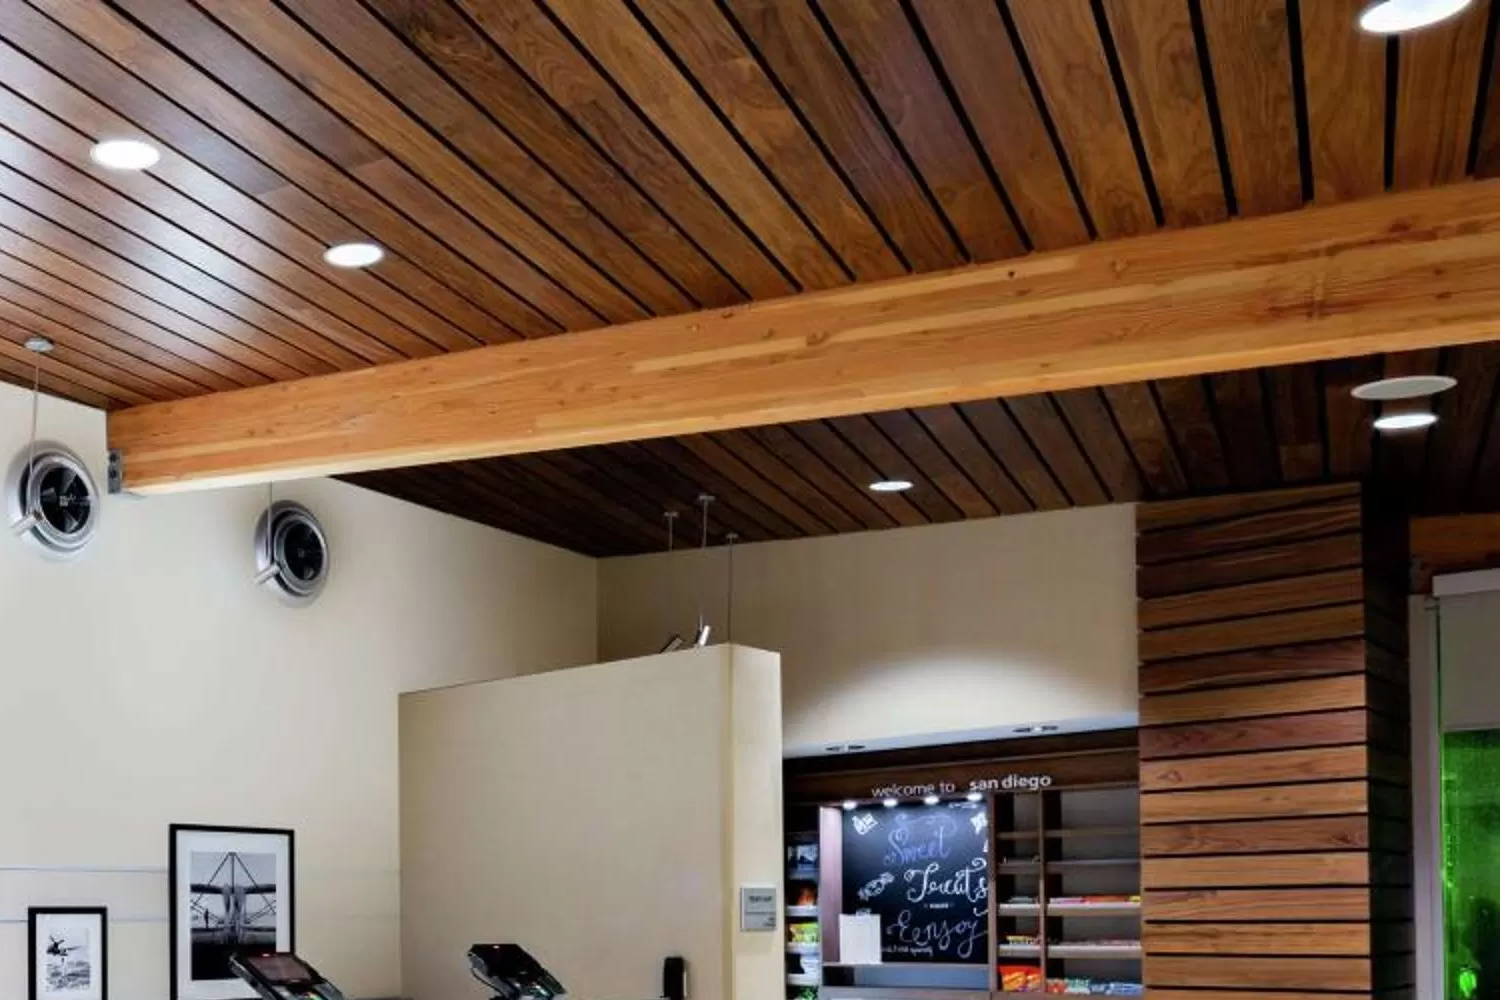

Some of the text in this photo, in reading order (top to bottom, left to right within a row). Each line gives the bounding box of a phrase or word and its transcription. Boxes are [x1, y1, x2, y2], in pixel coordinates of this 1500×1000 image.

[871, 774, 1053, 798] welcome to san diego
